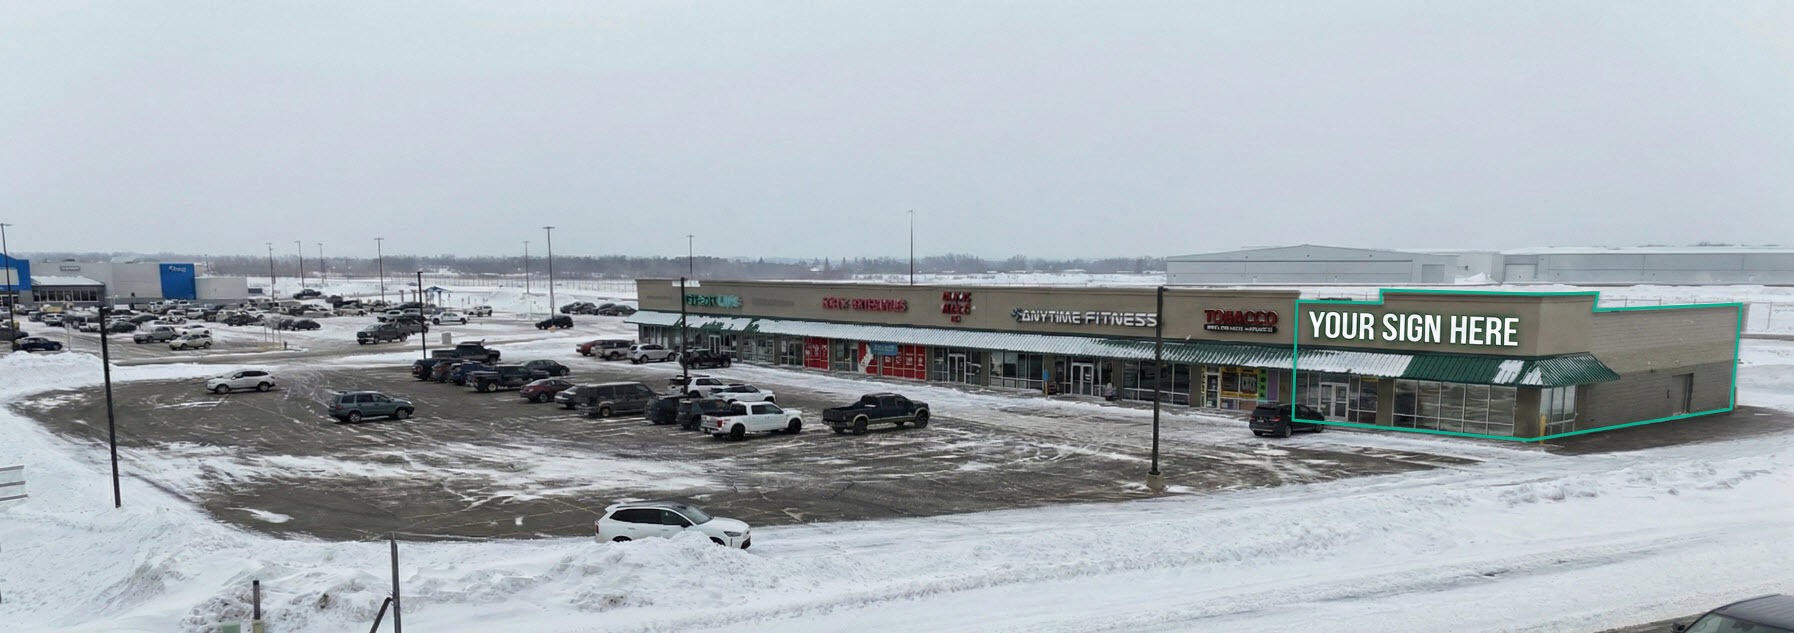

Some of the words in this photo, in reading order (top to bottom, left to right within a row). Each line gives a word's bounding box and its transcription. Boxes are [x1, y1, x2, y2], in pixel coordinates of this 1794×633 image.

[1021, 309, 1081, 324] ANYTIME
[1085, 311, 1158, 327] FITNESS
[1204, 309, 1278, 326] TOBACCO
